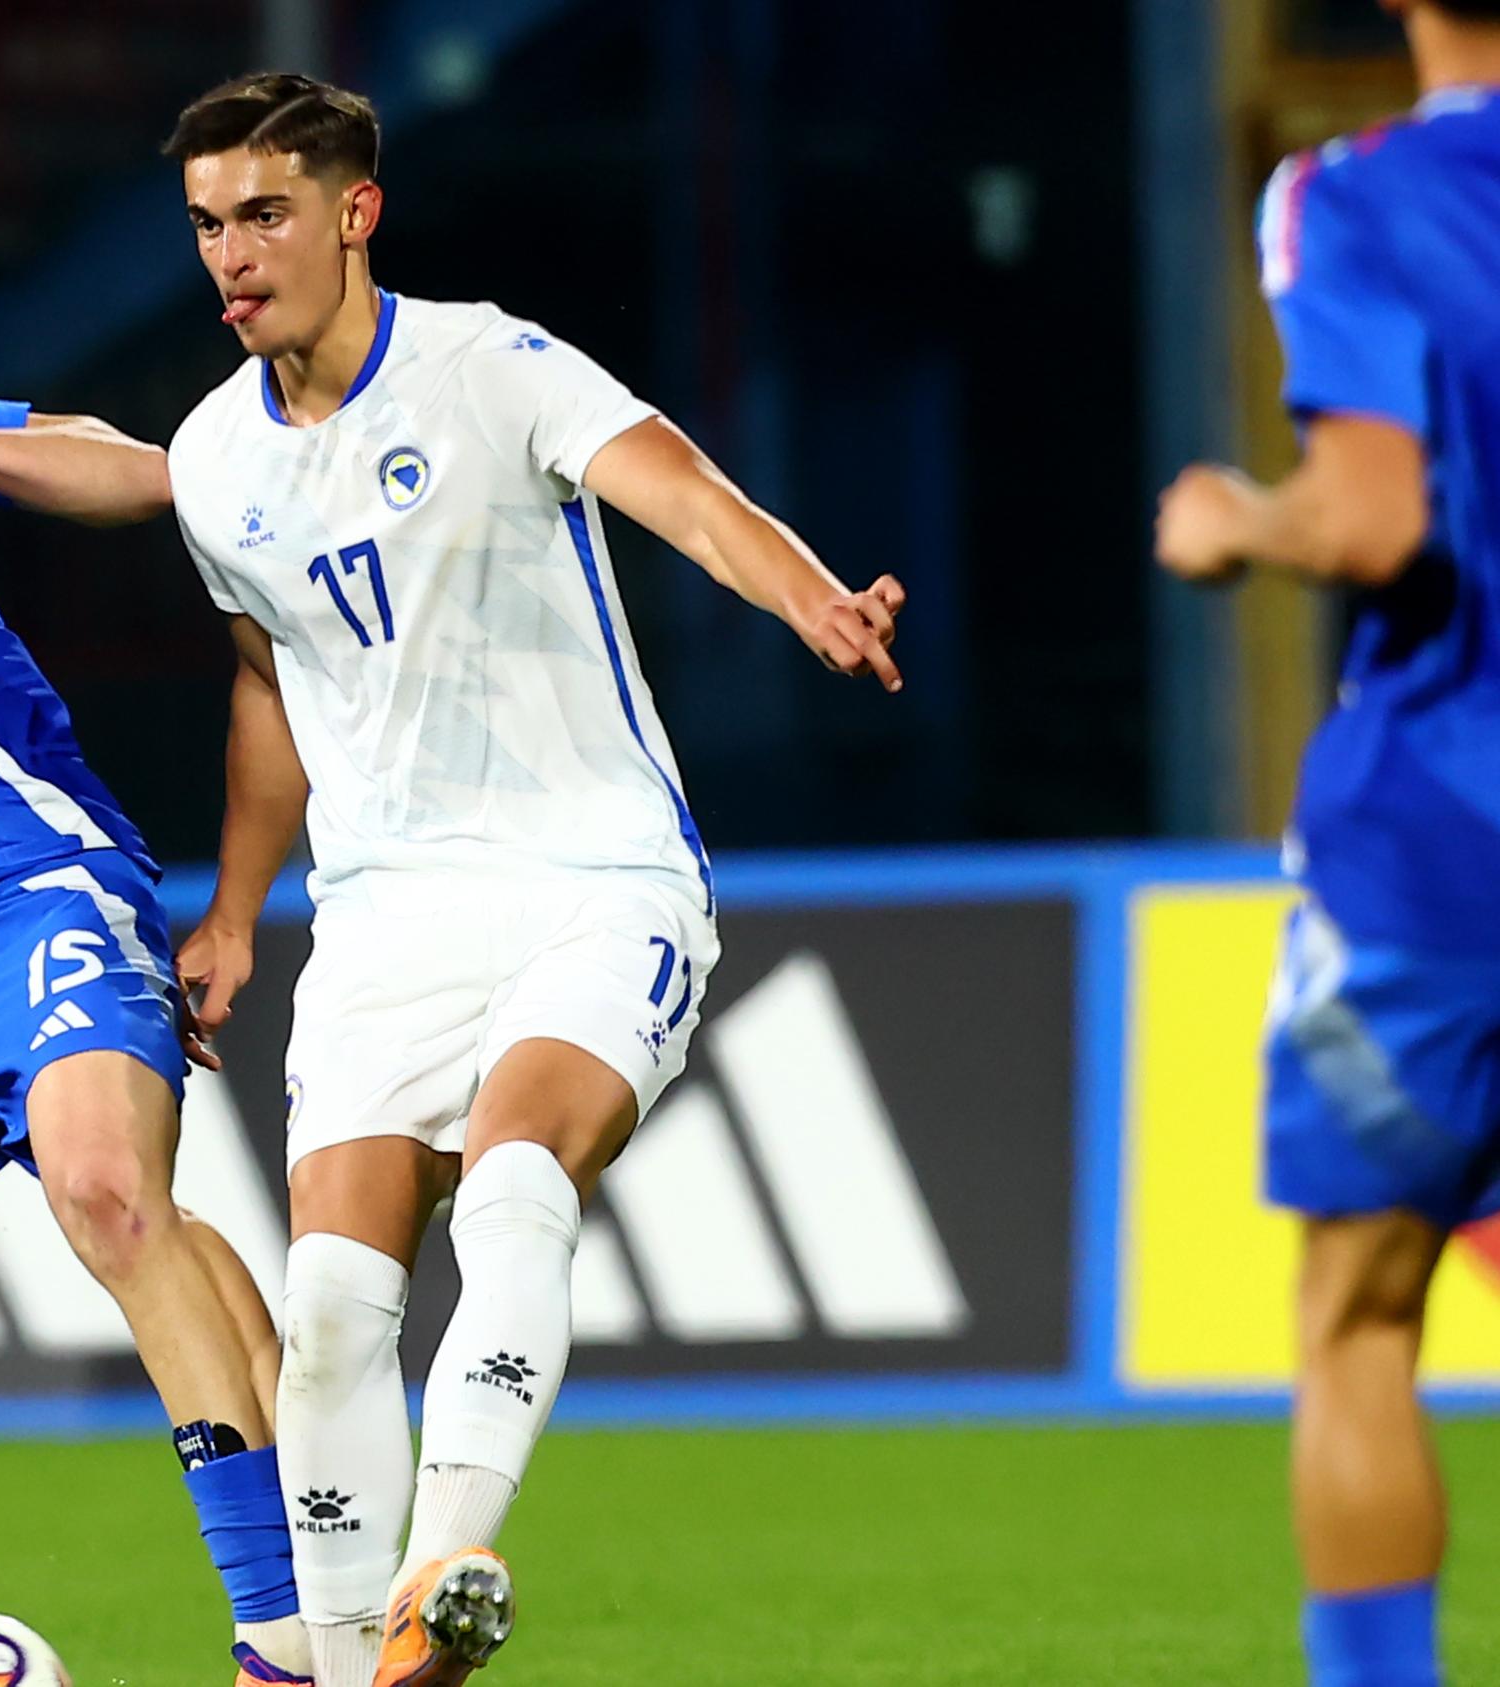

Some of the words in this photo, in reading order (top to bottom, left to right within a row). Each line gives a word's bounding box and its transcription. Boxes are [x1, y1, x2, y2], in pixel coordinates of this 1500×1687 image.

[238, 531, 276, 550] KELME
[308, 538, 395, 648] 17
[28, 929, 107, 1009] 15
[465, 1371, 534, 1406] KELME
[296, 1519, 360, 1533] KELME
